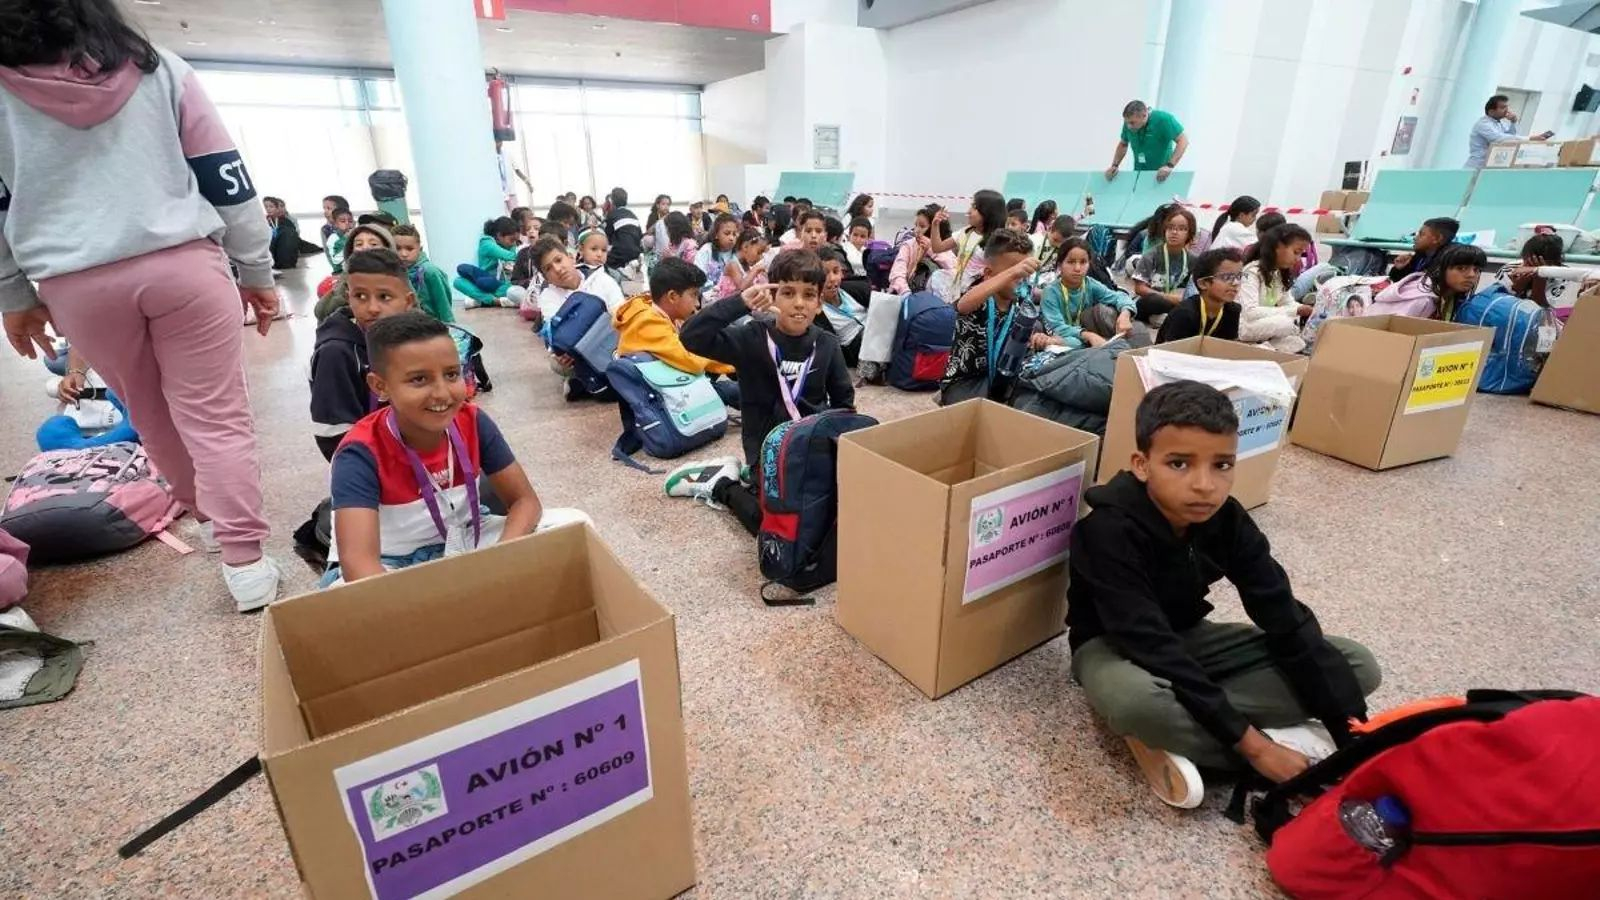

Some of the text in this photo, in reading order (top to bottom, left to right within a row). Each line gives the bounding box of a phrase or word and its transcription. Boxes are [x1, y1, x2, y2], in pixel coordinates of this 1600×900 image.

[1010, 495, 1074, 529] AVIÓN Nº 1
[969, 539, 1027, 569] PASAPORTE
[467, 713, 628, 793] AVIÓN Nº 1
[372, 798, 523, 875] PASAPORTE
[529, 784, 555, 808] Nº
[574, 751, 635, 785] 60609
